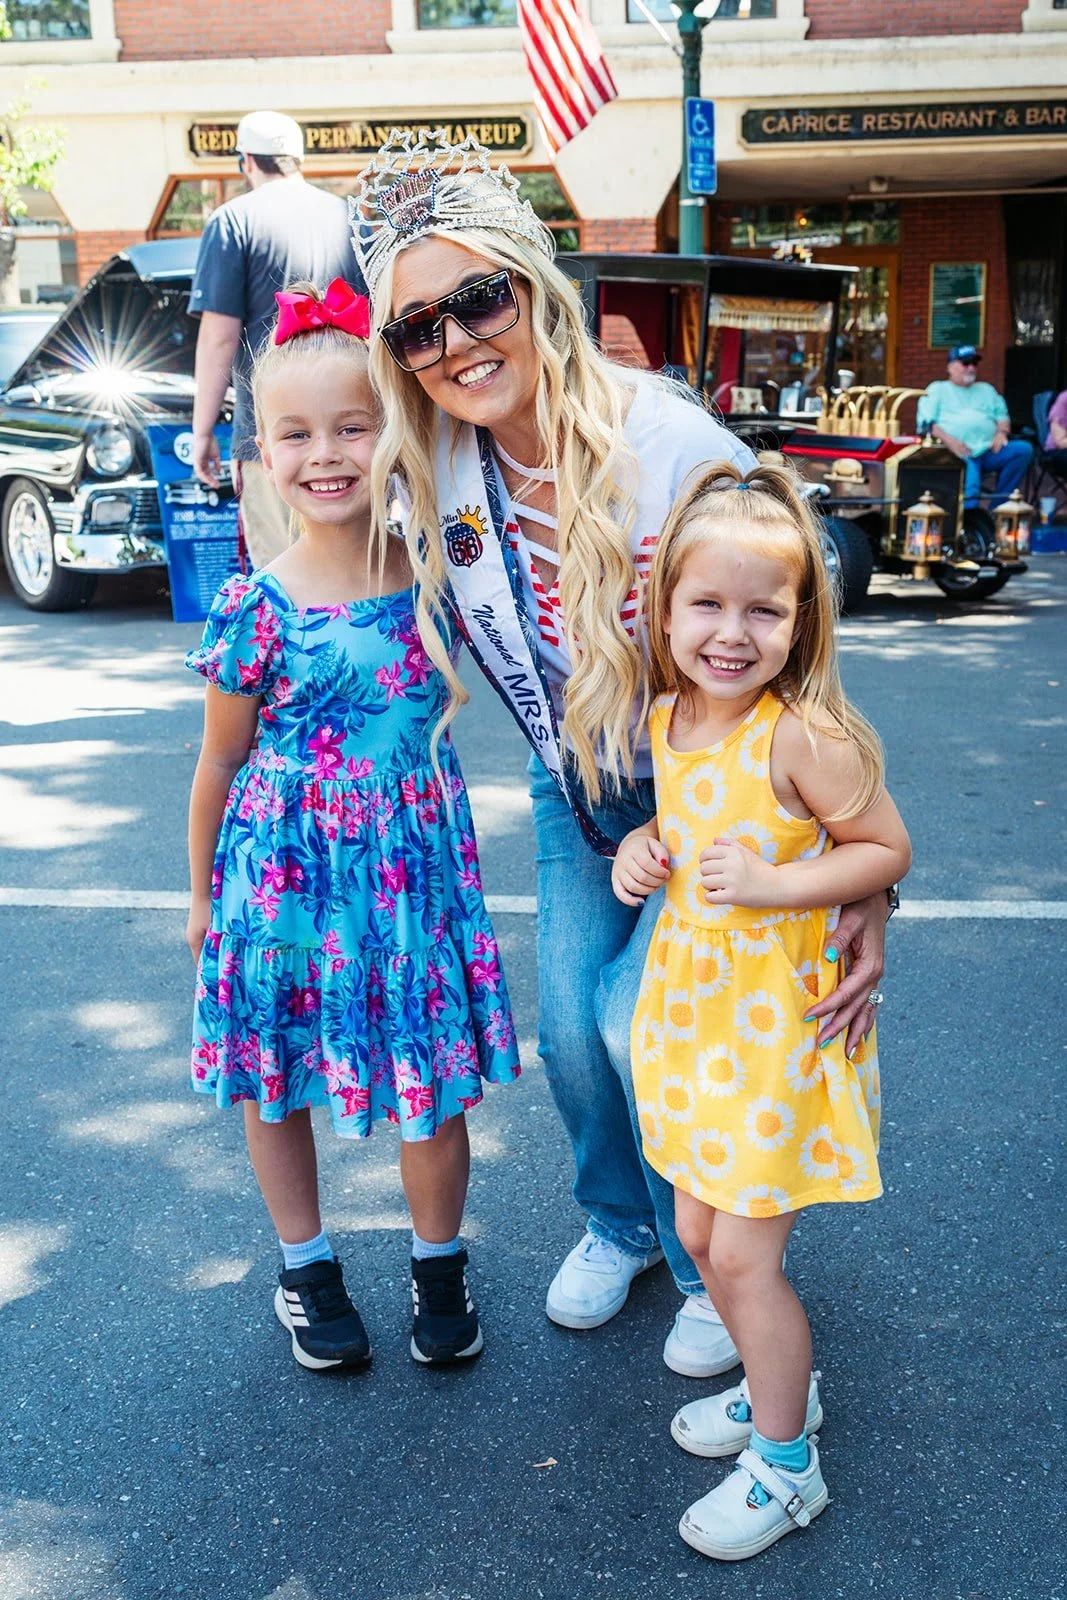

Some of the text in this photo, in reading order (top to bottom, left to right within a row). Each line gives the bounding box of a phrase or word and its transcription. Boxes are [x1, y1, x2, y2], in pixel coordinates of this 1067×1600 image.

[761, 106, 1066, 135] CAPRICE RESTAURANT & BAR
[194, 123, 521, 151] RED PERMANENT MAKEUP
[439, 514, 459, 528] Miss
[451, 535, 479, 563] 66
[471, 603, 549, 749] National MRS.
